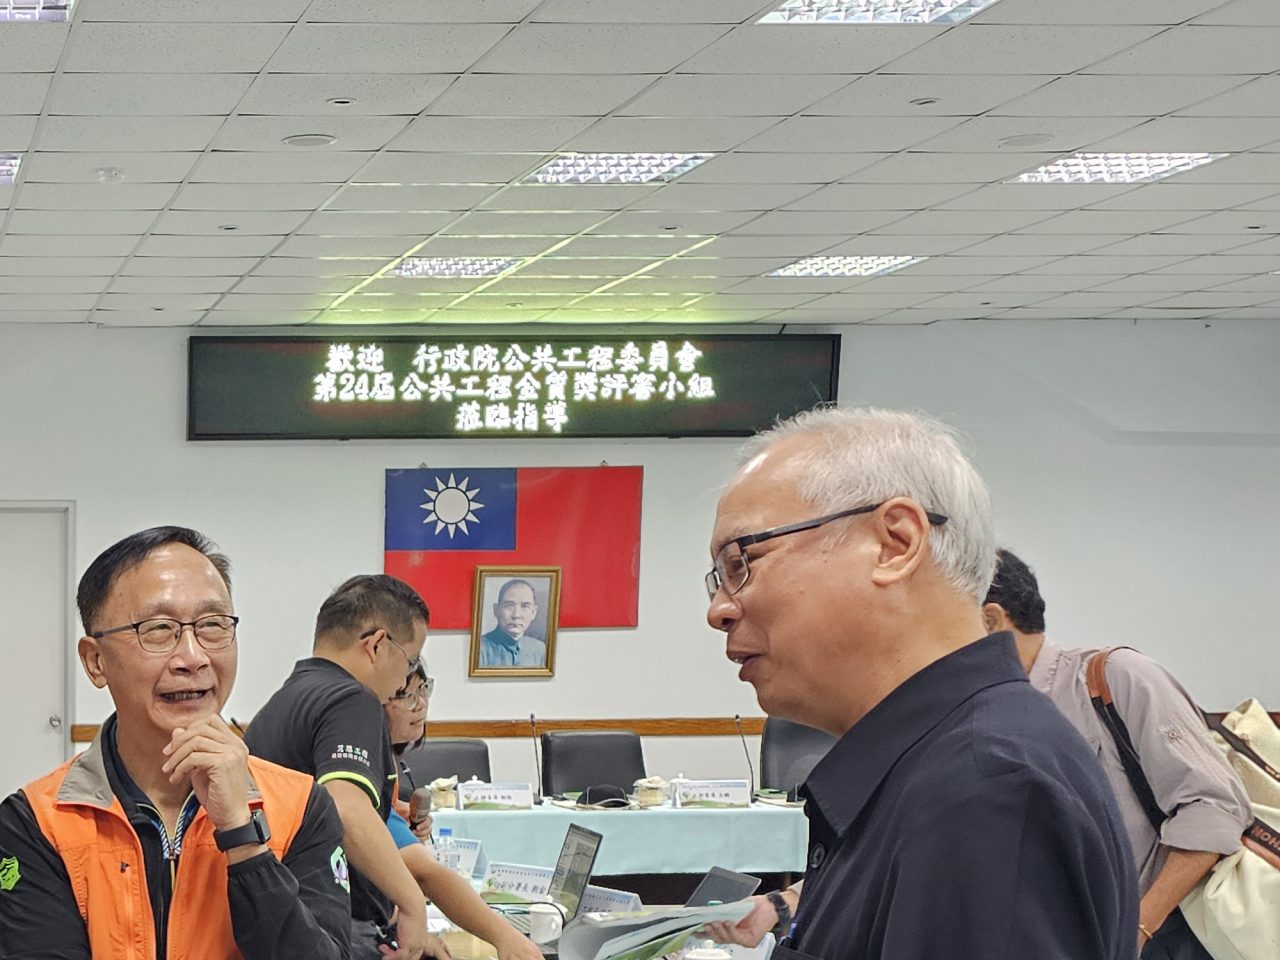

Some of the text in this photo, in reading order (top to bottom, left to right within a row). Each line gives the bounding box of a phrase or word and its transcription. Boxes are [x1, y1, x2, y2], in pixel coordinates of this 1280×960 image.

[325, 340, 703, 373] 歡迎 行政院公共工程委員會
